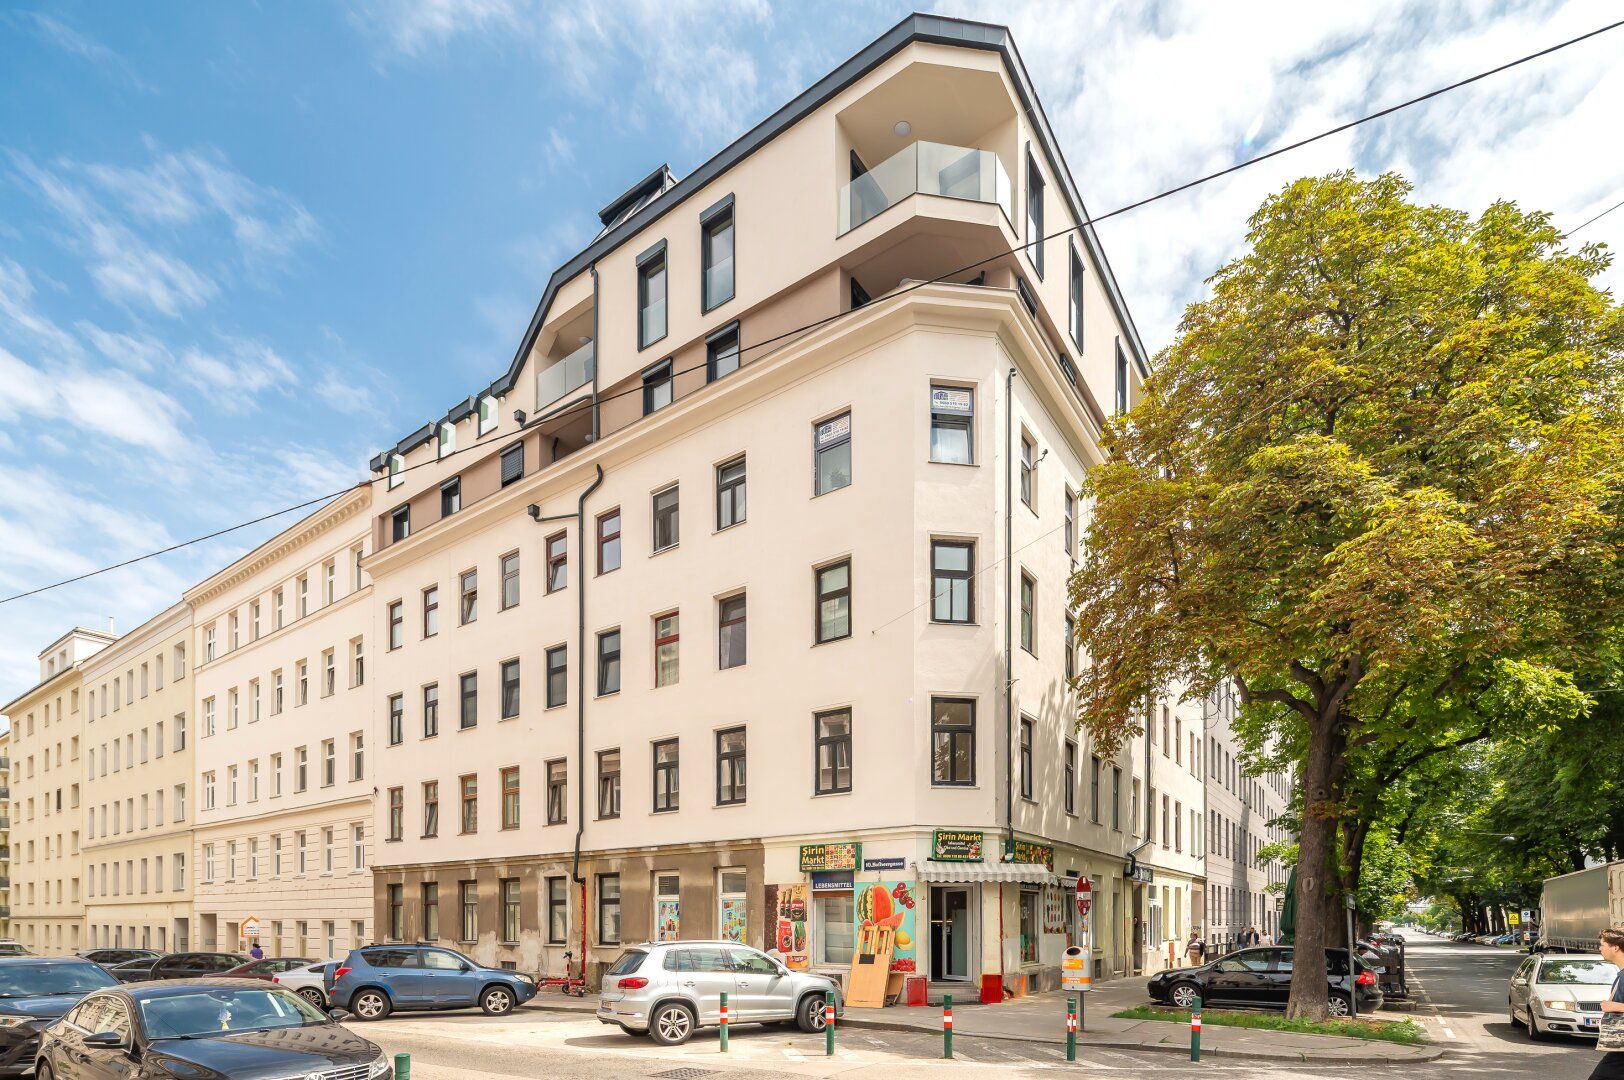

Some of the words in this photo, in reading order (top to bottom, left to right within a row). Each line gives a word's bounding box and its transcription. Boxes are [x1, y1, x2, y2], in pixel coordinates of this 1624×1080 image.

[938, 832, 956, 842] Şirin
[957, 833, 982, 841] Markt
[802, 846, 825, 856] Şirin
[801, 856, 825, 864] Markt
